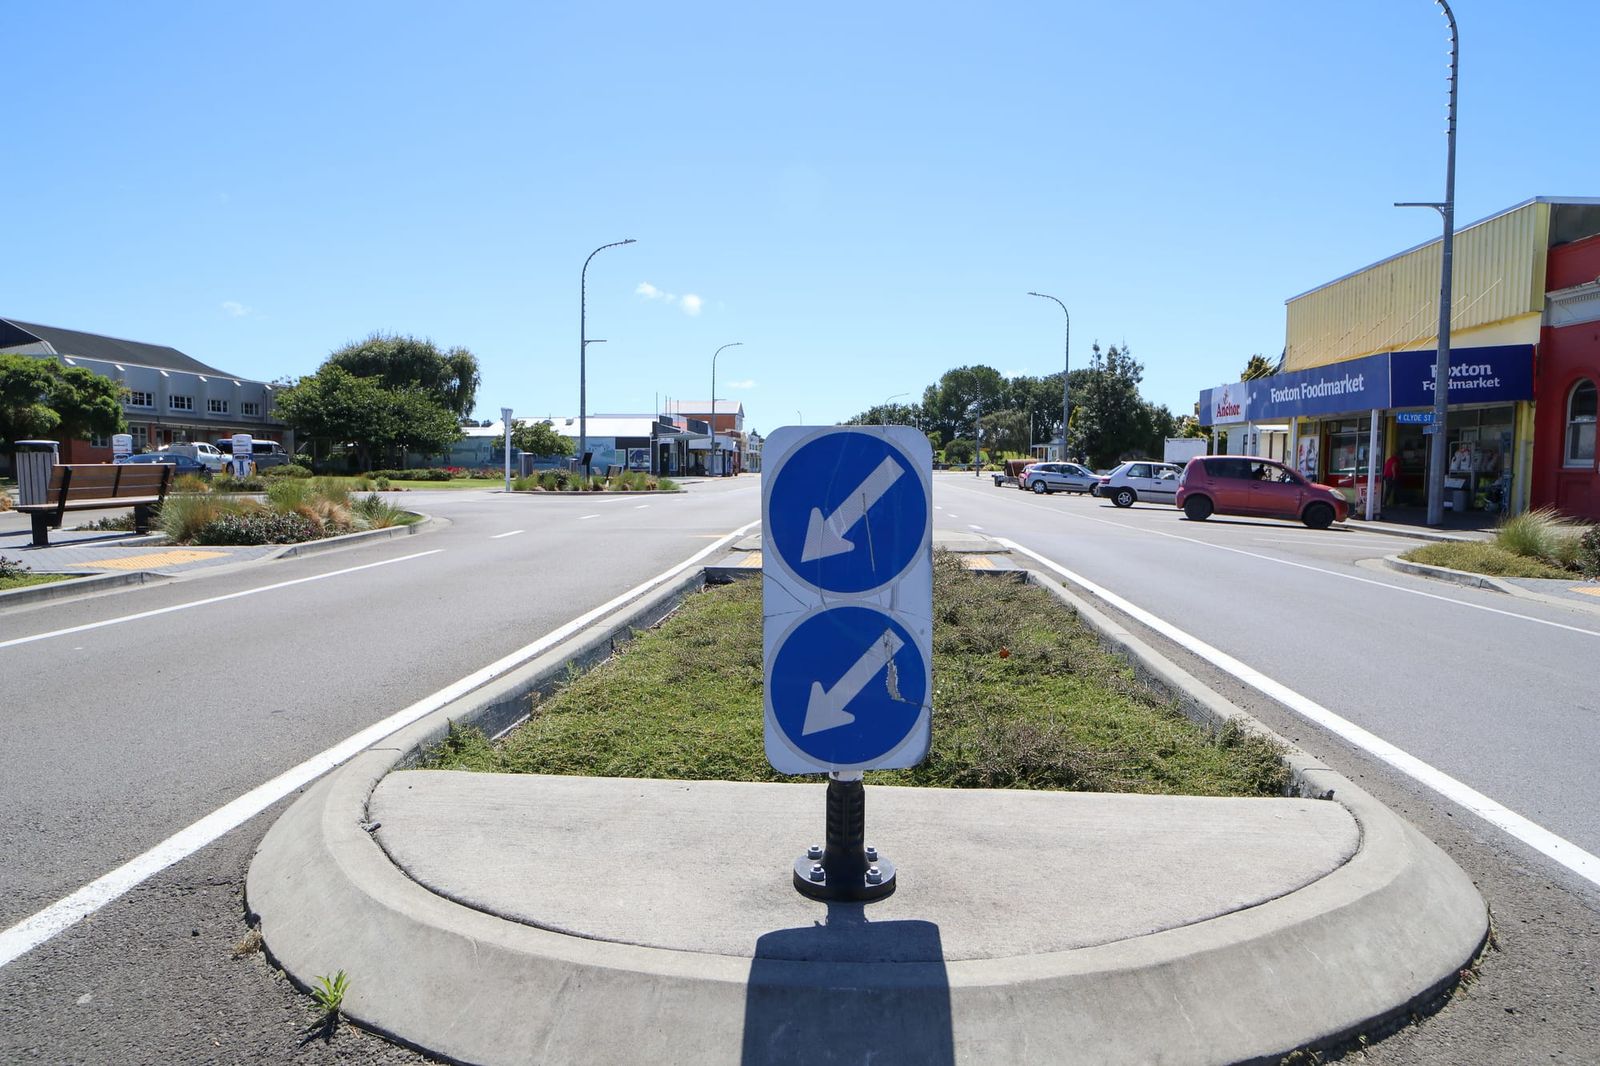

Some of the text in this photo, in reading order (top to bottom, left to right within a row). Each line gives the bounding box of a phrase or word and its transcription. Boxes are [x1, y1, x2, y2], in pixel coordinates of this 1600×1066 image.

[1270, 373, 1364, 403] Foxton Foodmarket
[1422, 377, 1501, 391] Fodmarket
[1216, 402, 1240, 417] Anchor
[1403, 413, 1431, 422] CLYDE ST
